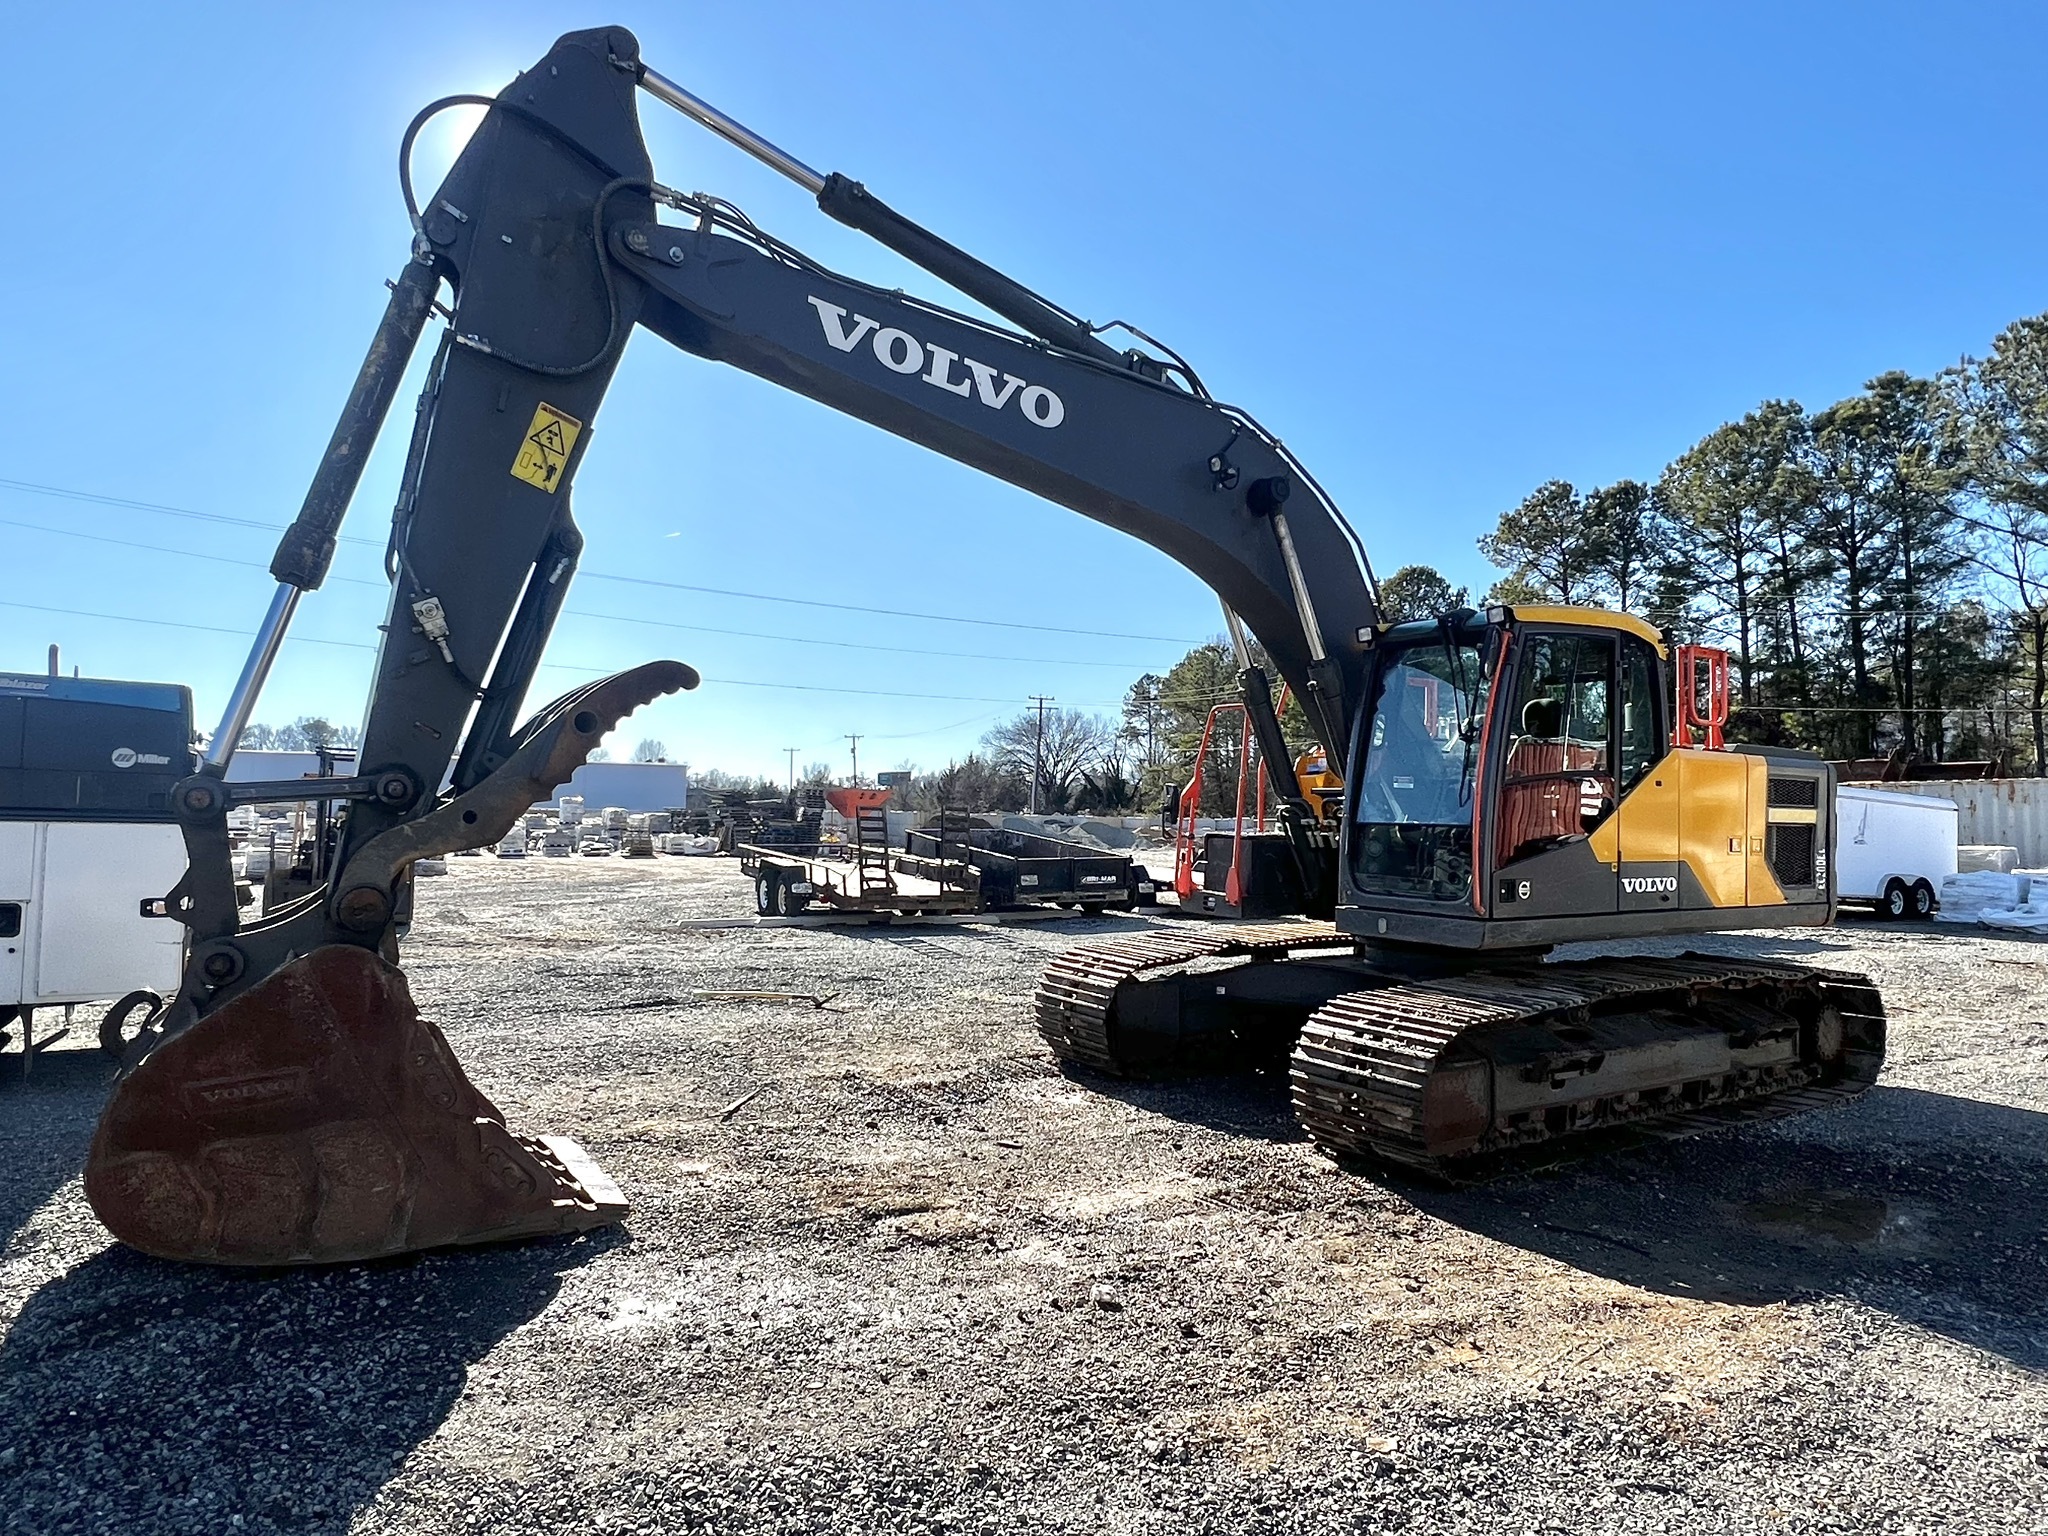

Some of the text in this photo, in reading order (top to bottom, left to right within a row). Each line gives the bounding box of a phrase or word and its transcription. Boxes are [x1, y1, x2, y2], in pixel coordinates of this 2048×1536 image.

[807, 295, 1065, 429] VOLVO
[137, 753, 171, 765] Miller
[1621, 876, 1678, 893] VOLVO
[200, 1079, 294, 1103] VOLVO
